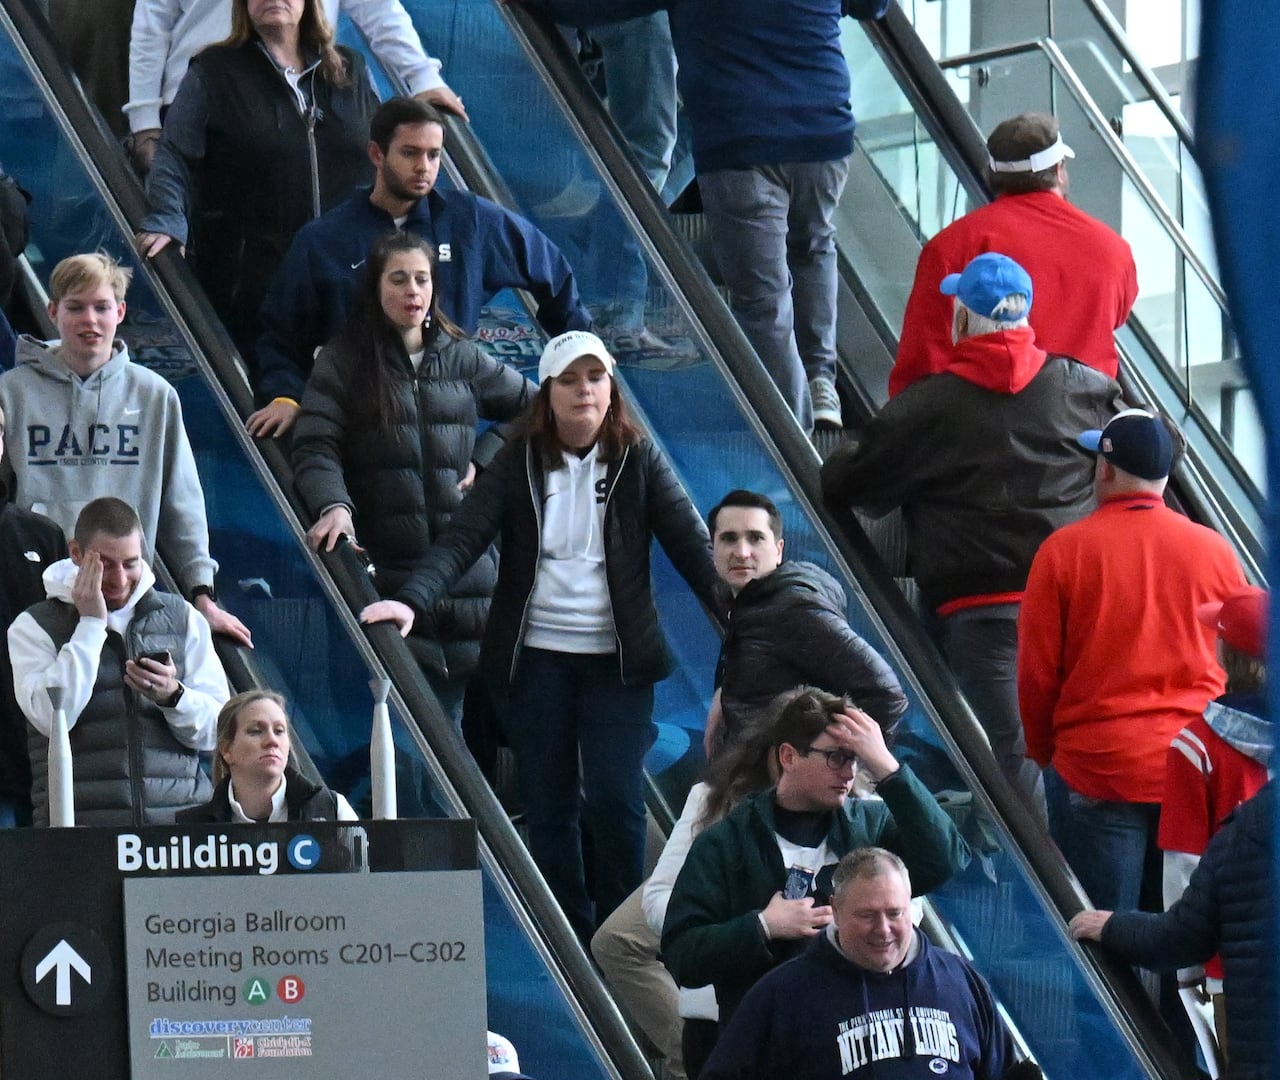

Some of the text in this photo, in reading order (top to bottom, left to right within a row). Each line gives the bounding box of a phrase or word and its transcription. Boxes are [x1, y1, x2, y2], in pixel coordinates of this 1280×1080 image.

[26, 424, 140, 457] PACE
[117, 834, 316, 874] Building C
[145, 911, 346, 939] Georgia Ballroom
[145, 948, 243, 973] Meeting
[252, 946, 329, 967] Rooms
[147, 981, 237, 1006] Building
[910, 1016, 959, 1062] LIONS
